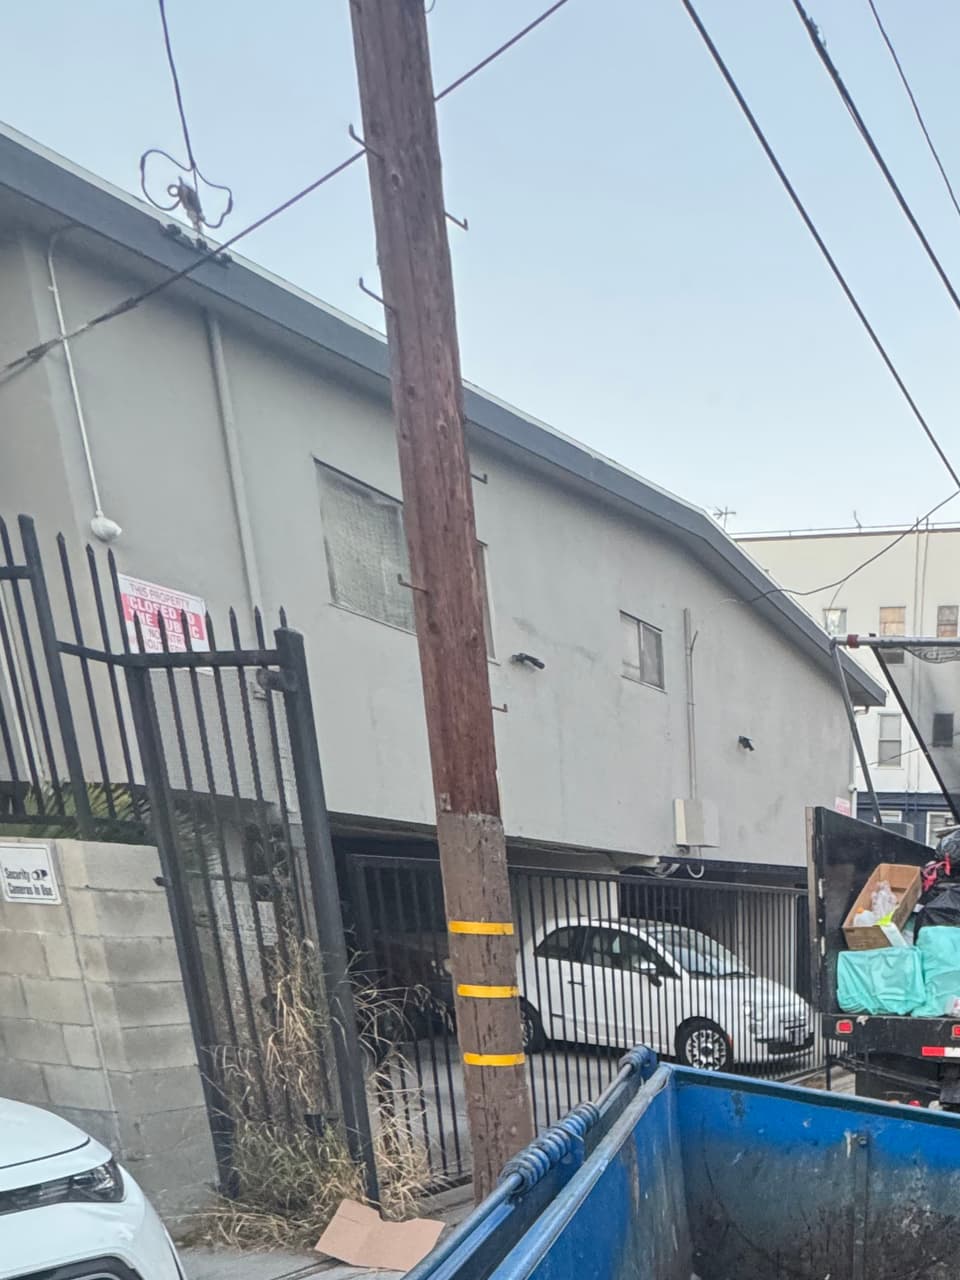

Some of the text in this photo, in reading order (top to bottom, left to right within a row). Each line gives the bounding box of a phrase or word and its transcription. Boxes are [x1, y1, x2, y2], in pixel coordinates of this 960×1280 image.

[129, 583, 190, 610] THIS PROPERTY
[129, 596, 177, 619] CLOSED
[4, 867, 31, 883] Security
[8, 882, 33, 895] Cameras
